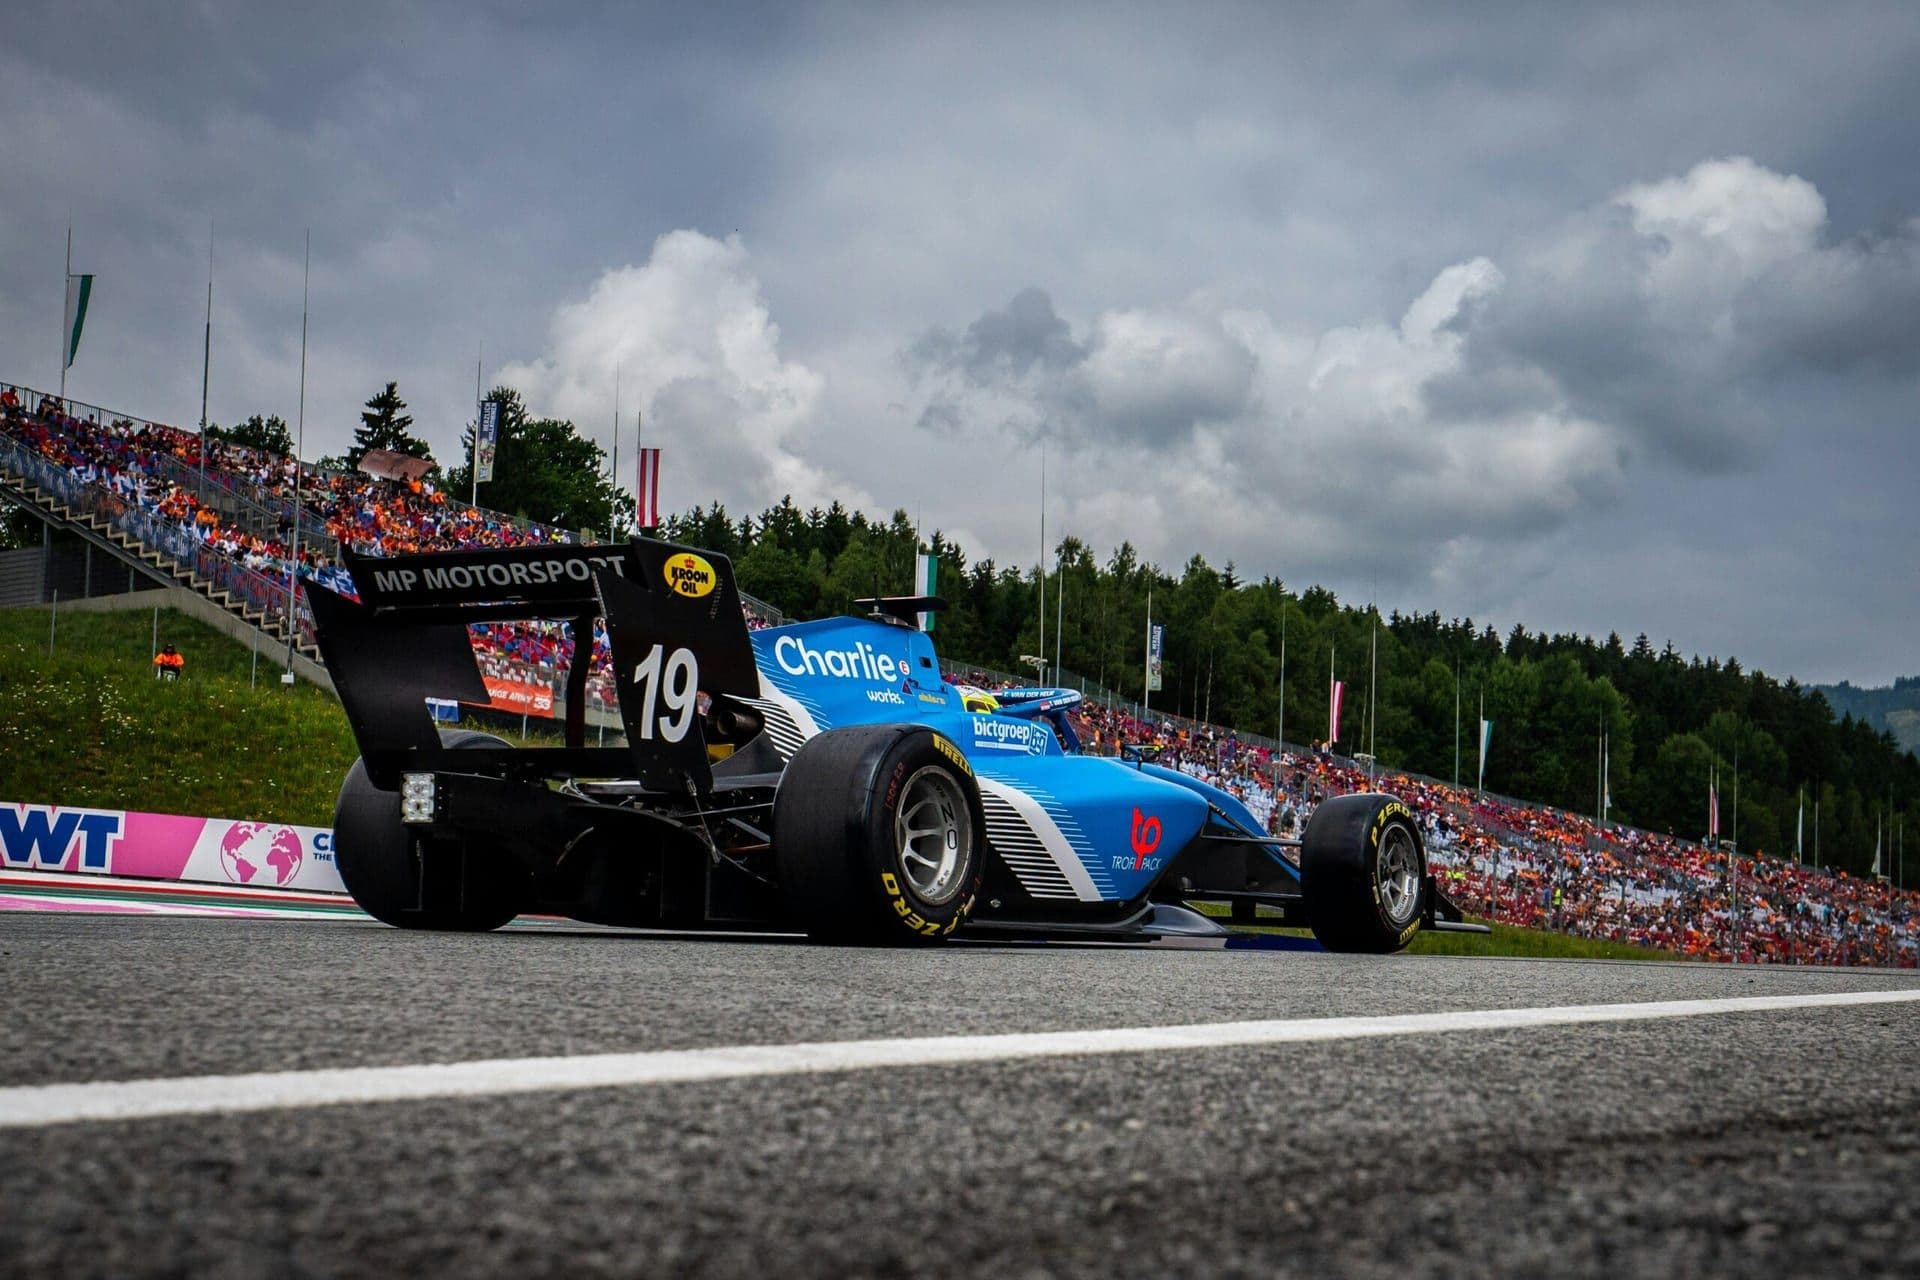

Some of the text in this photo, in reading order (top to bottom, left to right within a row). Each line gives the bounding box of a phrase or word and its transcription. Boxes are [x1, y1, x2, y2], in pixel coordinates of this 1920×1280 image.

[374, 569, 417, 592] MP
[671, 566, 709, 585] KROON
[681, 581, 698, 595] OIL
[774, 634, 898, 683] Charlie
[633, 644, 699, 743] 19
[972, 716, 1030, 745] bictgroep
[931, 732, 973, 778] PIRELLI
[1378, 802, 1411, 827] ZERO
[313, 852, 333, 862] THE
[882, 872, 941, 936] ZERO
